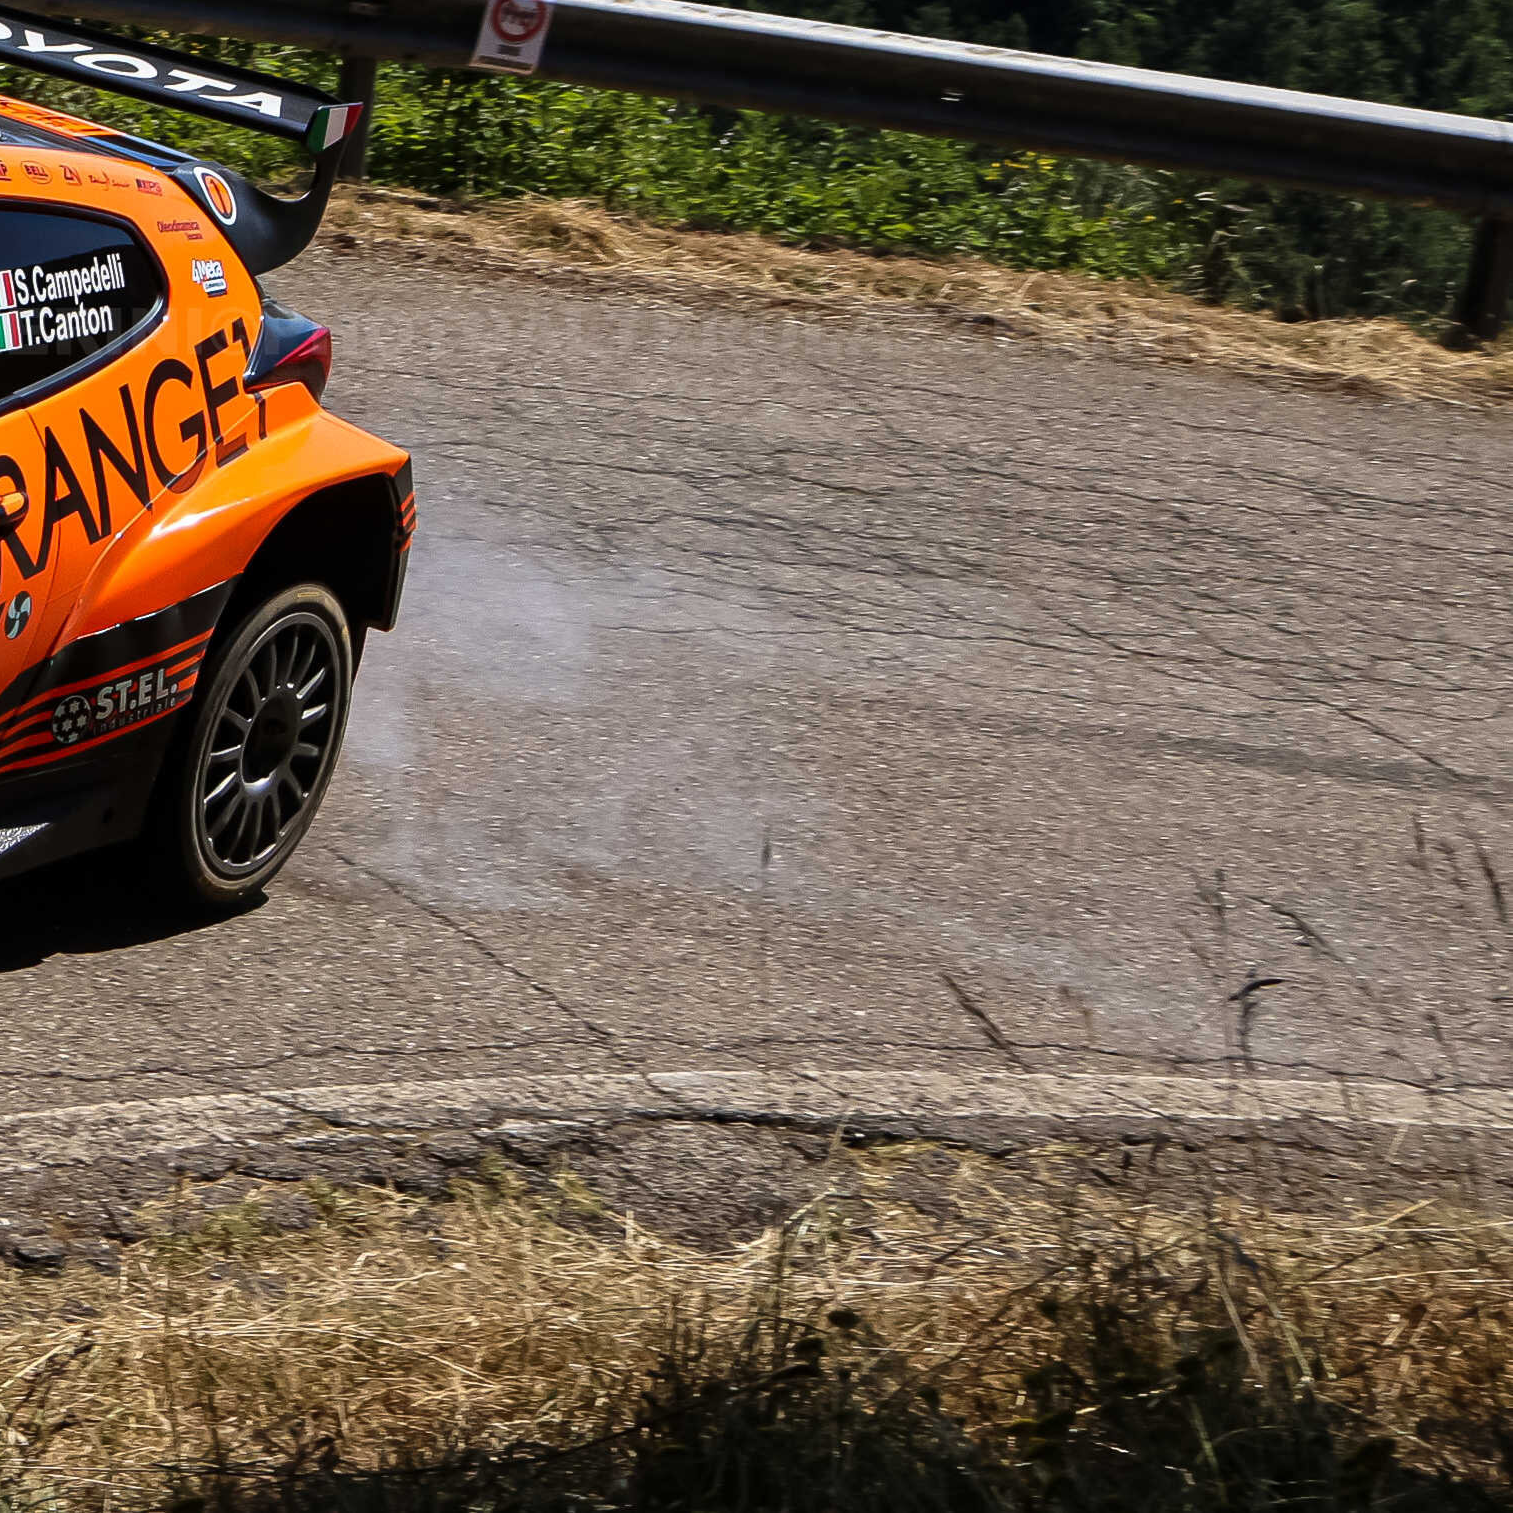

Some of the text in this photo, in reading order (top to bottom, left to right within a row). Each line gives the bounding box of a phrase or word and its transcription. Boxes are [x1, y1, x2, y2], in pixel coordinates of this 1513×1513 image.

[24, 164, 49, 178] BELL
[14, 252, 125, 306] S.Campedelli
[20, 301, 114, 347] T.Canton
